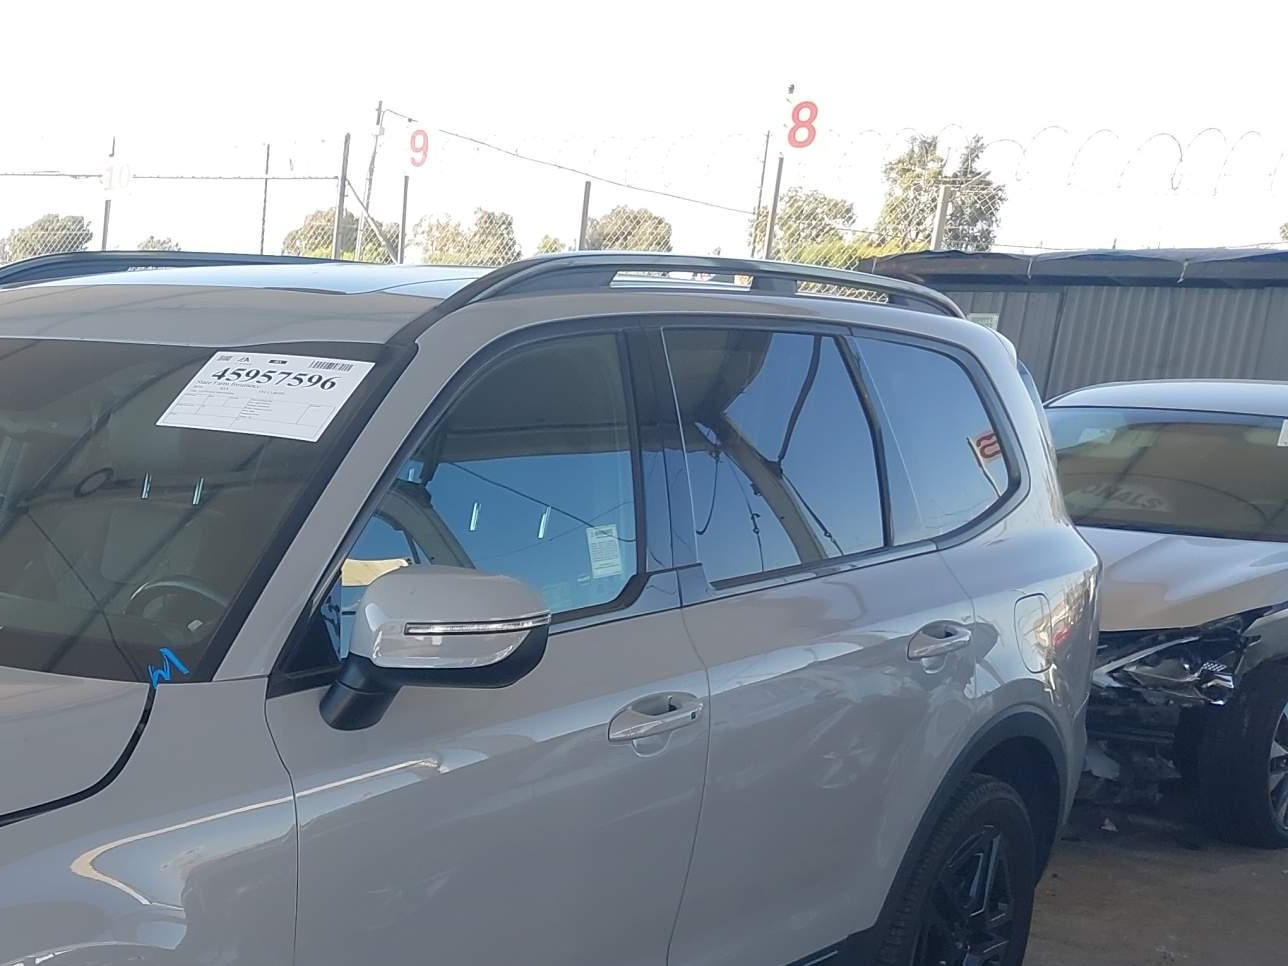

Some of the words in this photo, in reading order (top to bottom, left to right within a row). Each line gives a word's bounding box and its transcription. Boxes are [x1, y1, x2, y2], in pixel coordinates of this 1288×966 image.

[786, 100, 819, 148] 8
[410, 129, 429, 167] 9
[211, 367, 342, 391] 45957596
